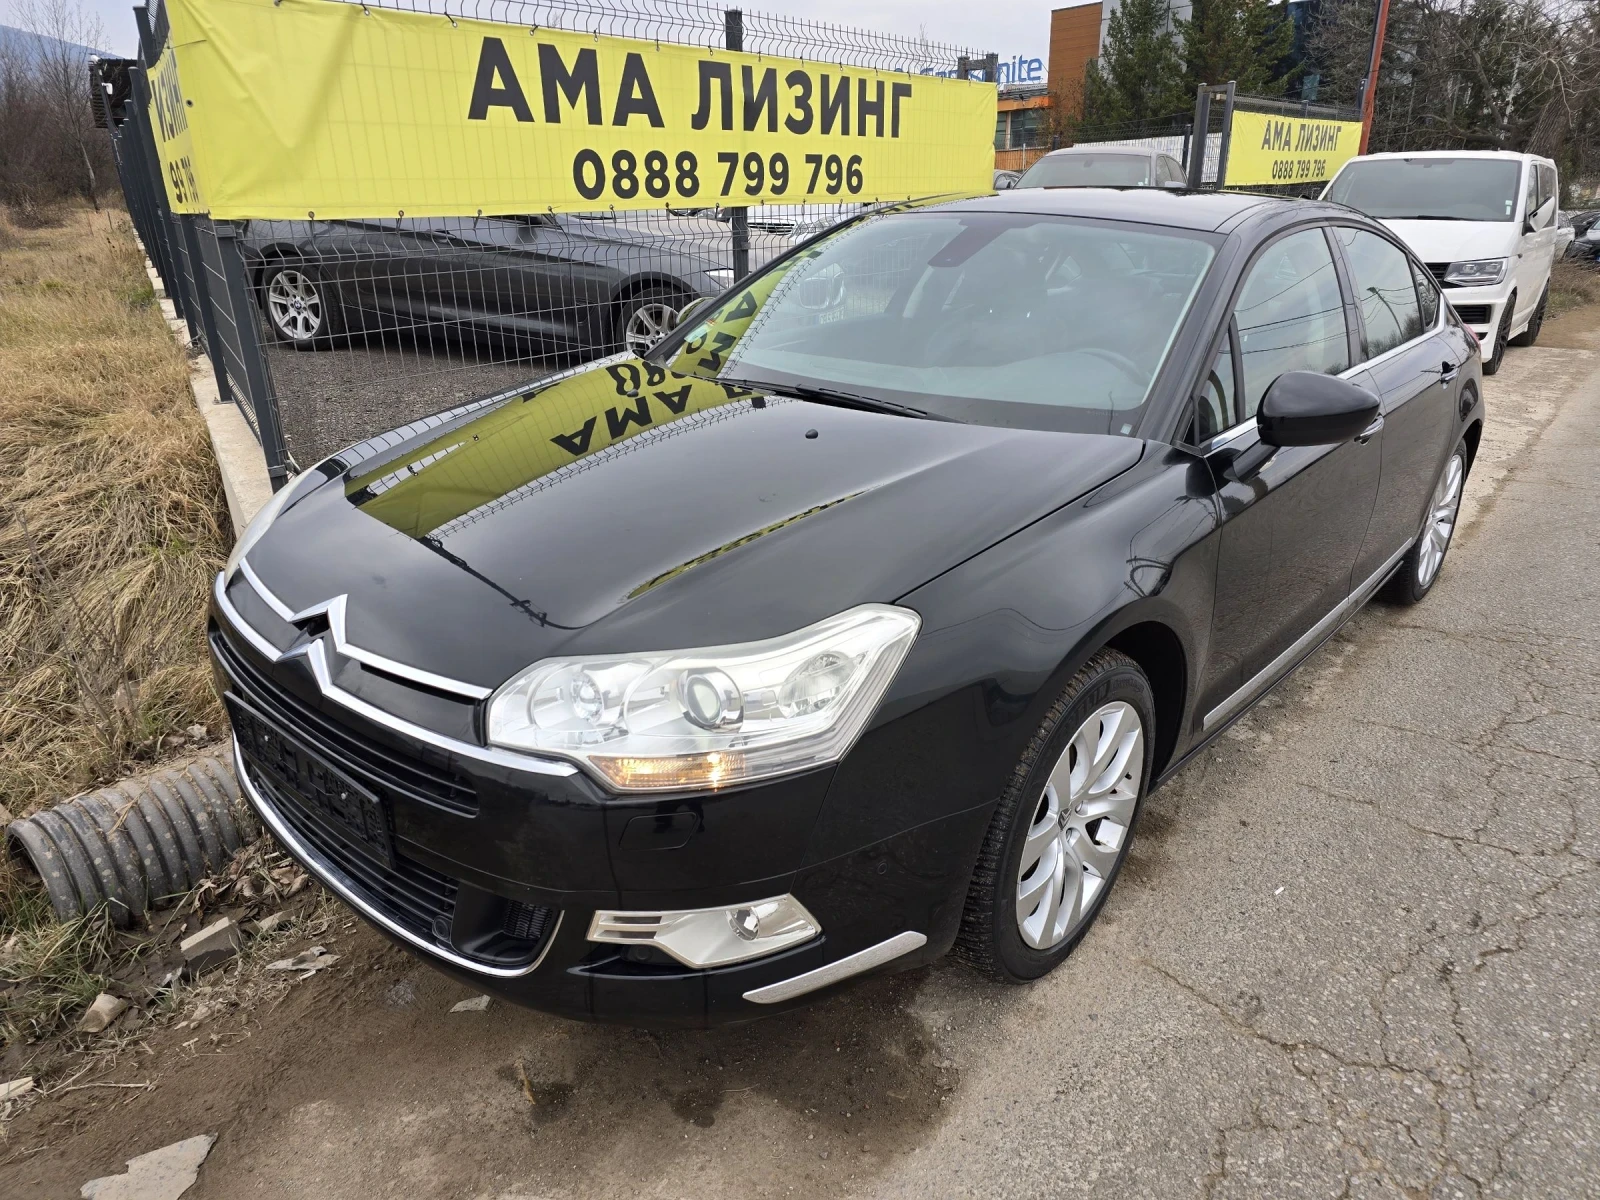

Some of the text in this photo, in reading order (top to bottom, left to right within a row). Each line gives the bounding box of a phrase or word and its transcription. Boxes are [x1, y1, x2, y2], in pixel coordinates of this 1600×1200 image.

[467, 36, 913, 138] АМА ЛИЗИНГ
[1261, 120, 1342, 152] АМА ЛИЗИНГ
[572, 148, 864, 200] 0888 799 796
[1272, 159, 1326, 180] 0888 799 796
